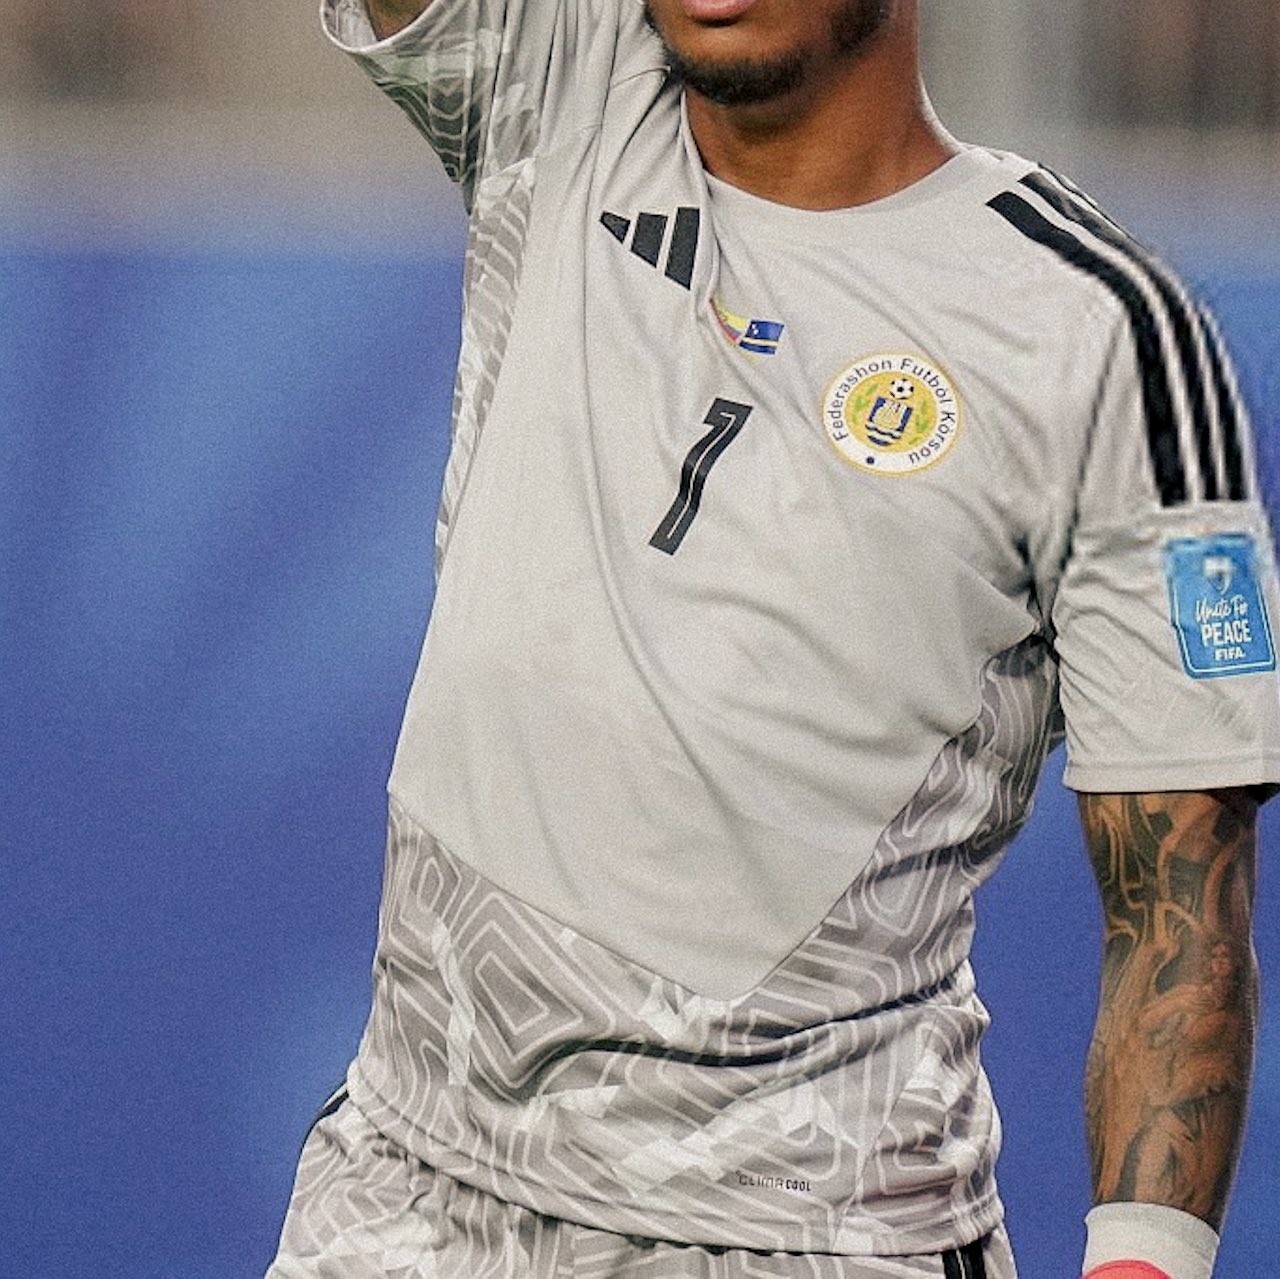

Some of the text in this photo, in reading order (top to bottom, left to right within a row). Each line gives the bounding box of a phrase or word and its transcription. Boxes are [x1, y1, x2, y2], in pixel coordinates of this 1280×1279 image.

[827, 359, 892, 442] Federashon
[648, 397, 754, 556] 1
[1195, 596, 1232, 624] Unite
[1200, 618, 1253, 647] PEACE
[1214, 646, 1247, 661] FIFA
